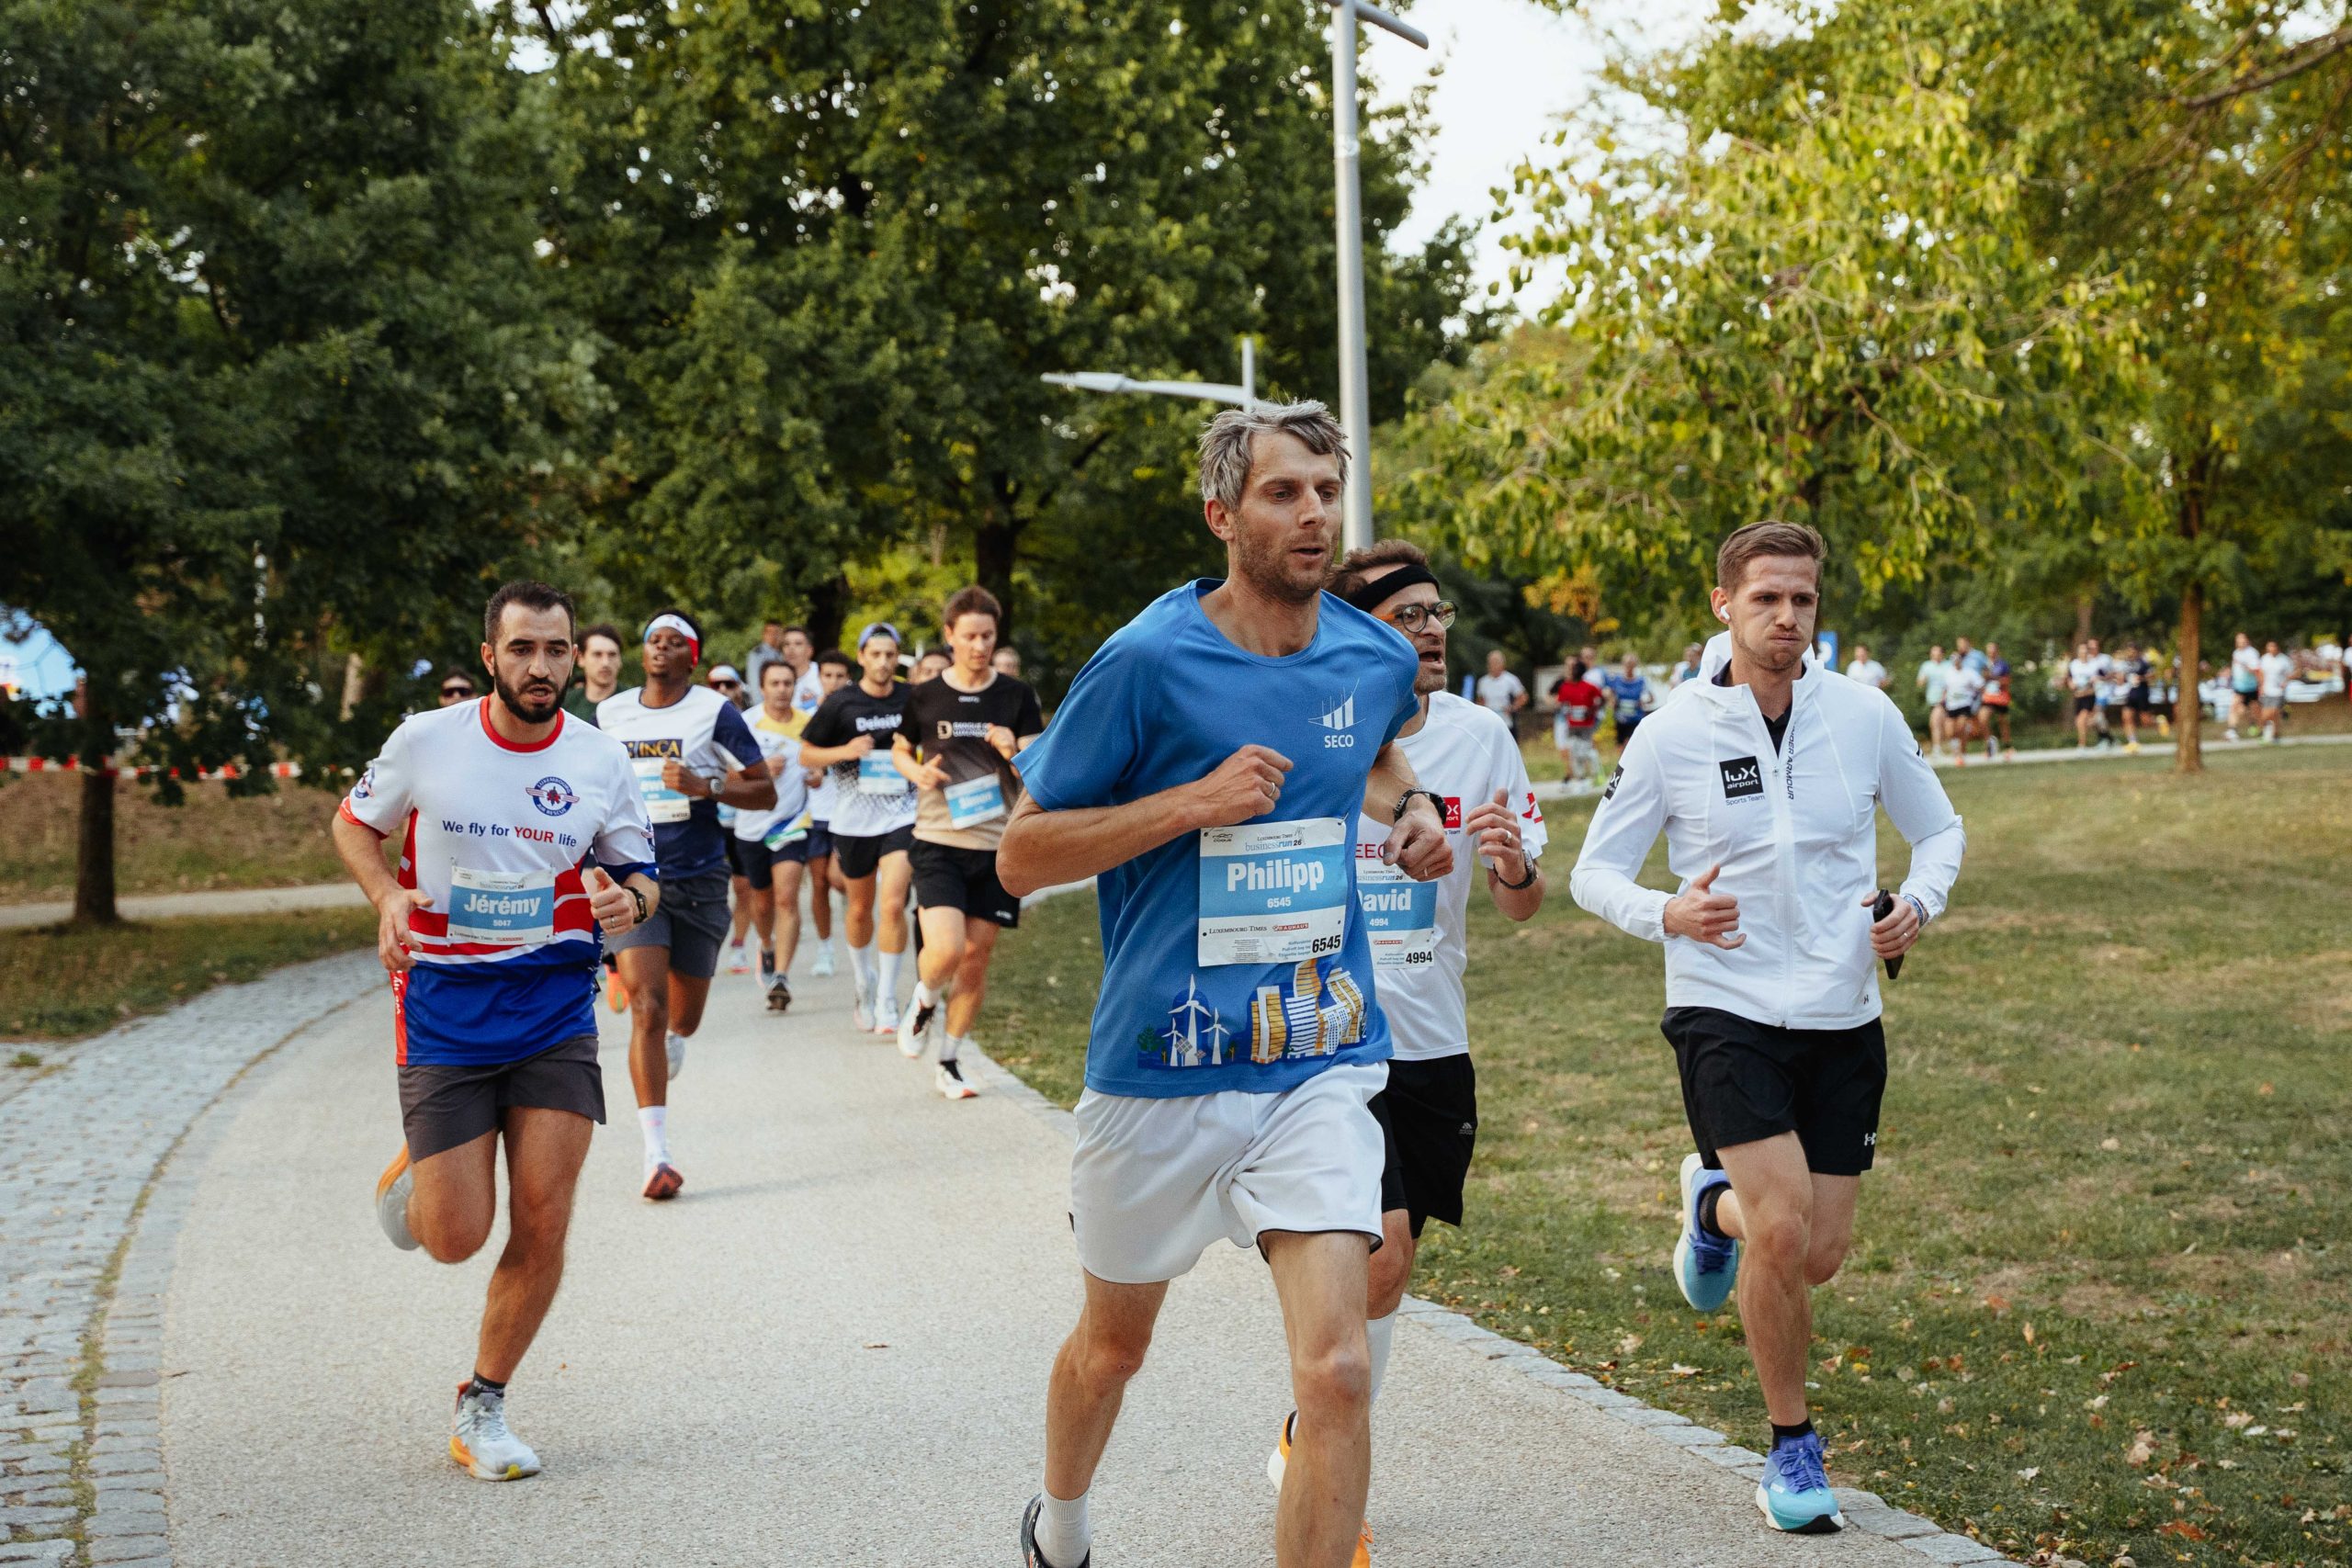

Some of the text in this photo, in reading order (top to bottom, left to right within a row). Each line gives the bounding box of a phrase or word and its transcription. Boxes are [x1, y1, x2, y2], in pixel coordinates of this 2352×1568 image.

[639, 739, 680, 758] INCA
[1324, 734, 1354, 749] SECO
[1727, 778, 1759, 789] airport
[1785, 755, 1794, 800] ARMOUR
[1726, 797, 1747, 806] Sports
[442, 819, 577, 847] We fly for YOUR life
[1227, 858, 1324, 893] Philipp
[464, 893, 541, 917] Jérémy
[1267, 897, 1292, 908] 6545
[1209, 925, 1248, 934] LUXEMBOURG
[1370, 918, 1389, 927] 4994
[1312, 934, 1341, 953] 6545
[1406, 951, 1433, 964] 4994
